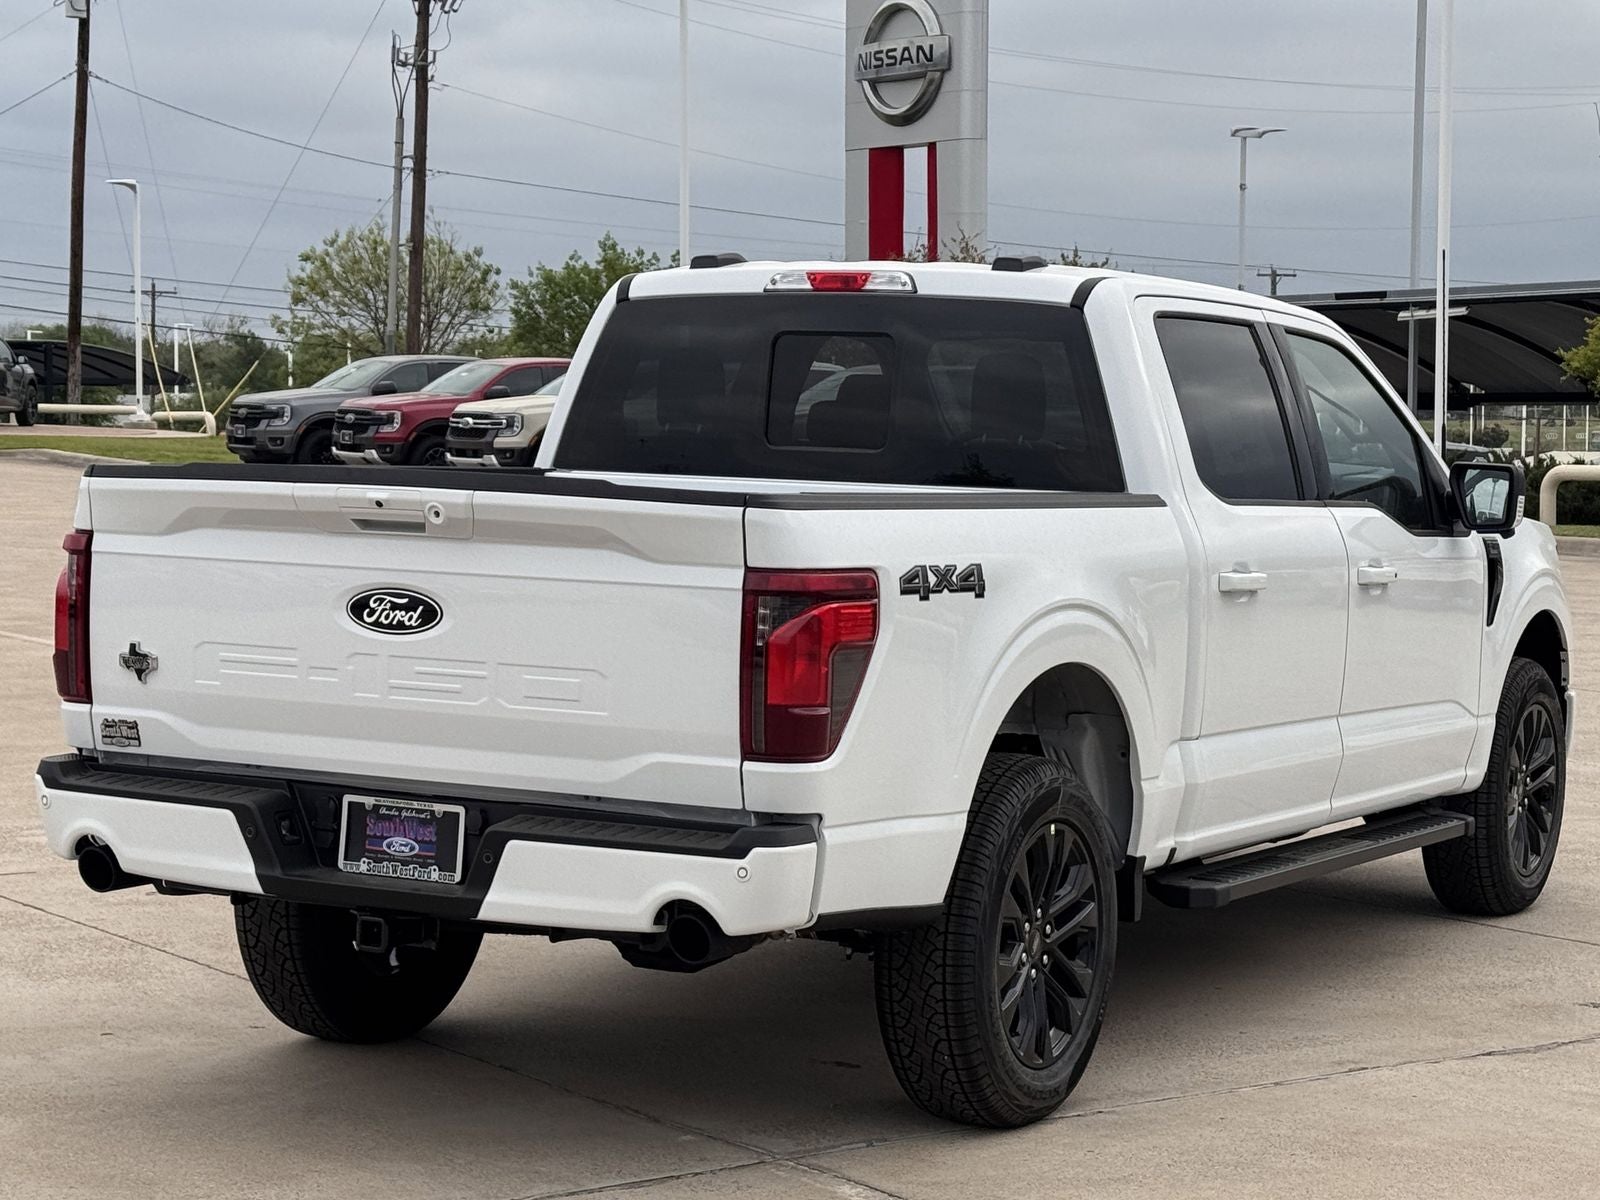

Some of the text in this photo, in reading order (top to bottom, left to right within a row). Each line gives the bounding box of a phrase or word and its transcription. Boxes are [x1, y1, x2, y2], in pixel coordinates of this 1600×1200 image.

[857, 43, 934, 72] NISSAN
[362, 594, 425, 627] Ford
[390, 840, 412, 853] Ford
